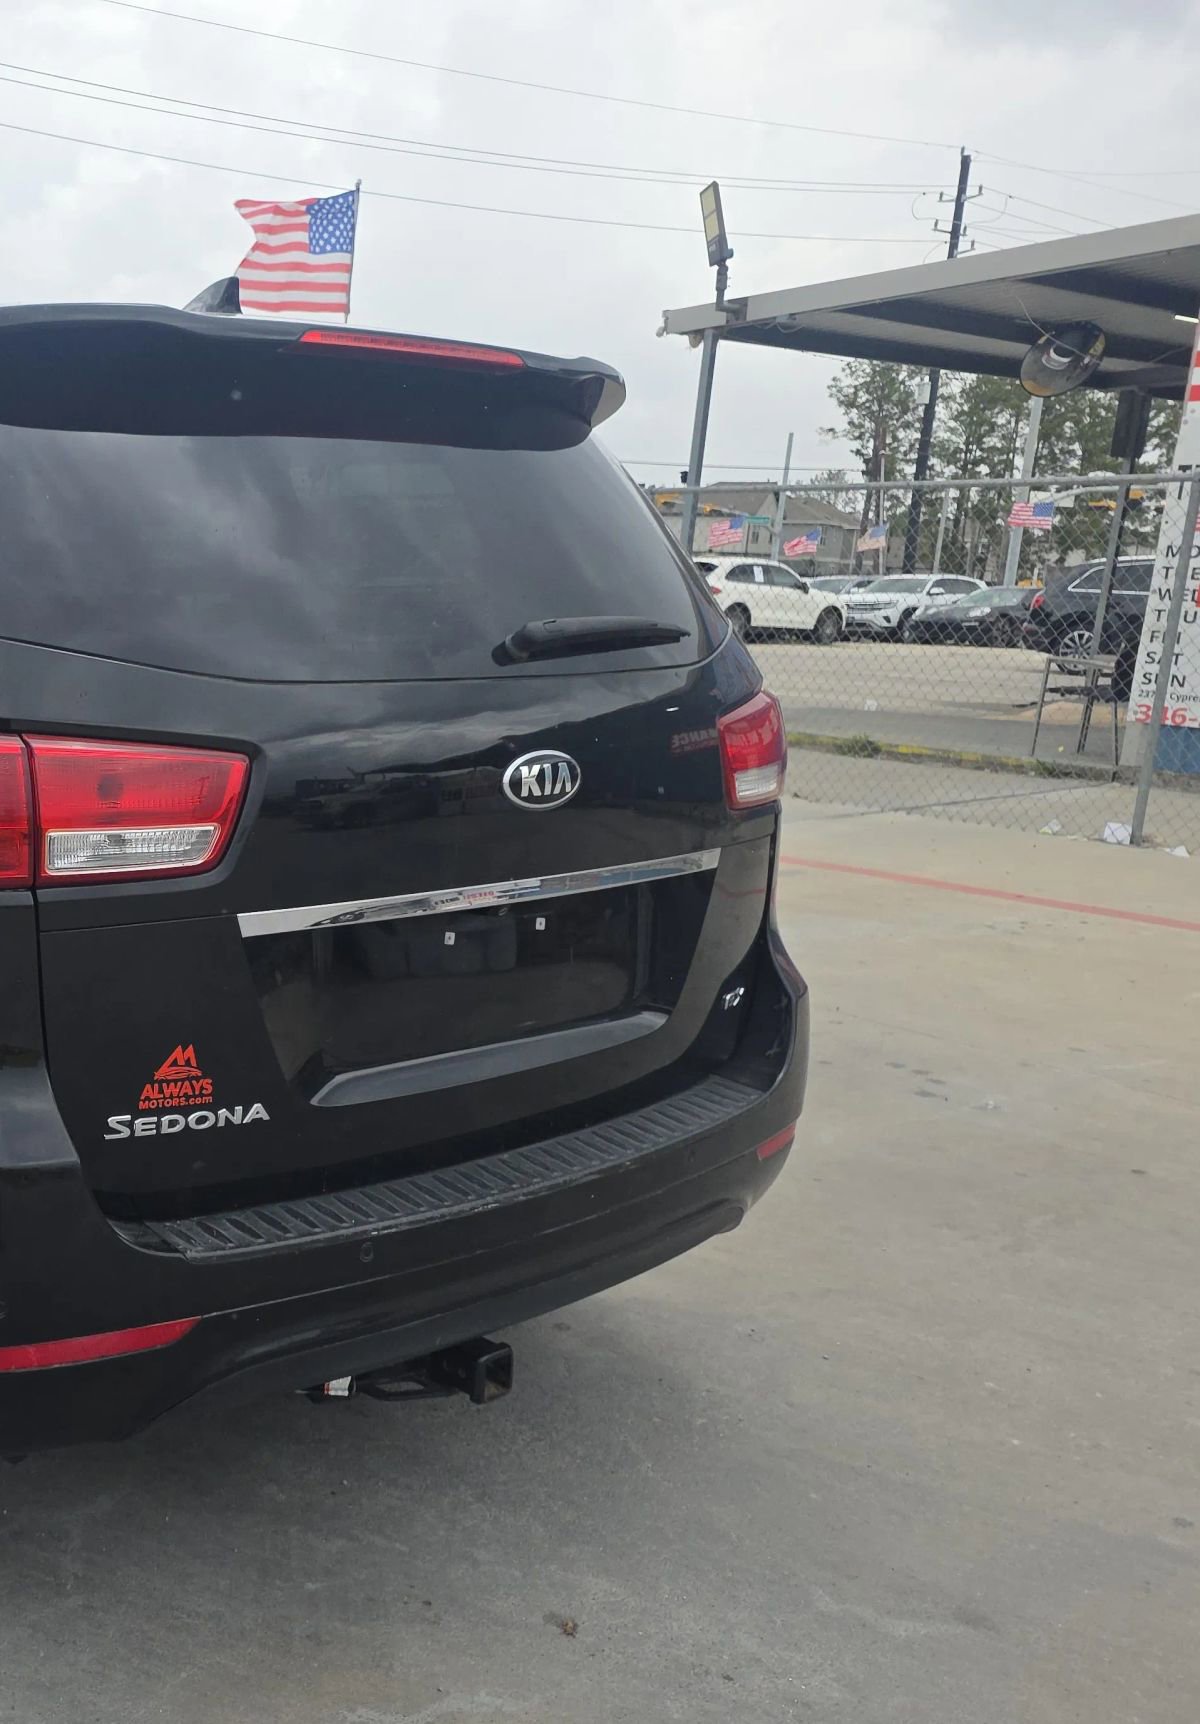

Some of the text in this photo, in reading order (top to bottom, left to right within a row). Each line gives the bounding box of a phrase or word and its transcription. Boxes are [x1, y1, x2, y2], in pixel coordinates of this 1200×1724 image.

[1162, 566, 1200, 580] TE
[1154, 609, 1197, 623] TU
[1150, 630, 1181, 644] FI
[1145, 651, 1183, 665] ST
[1141, 672, 1185, 687] SN
[1170, 692, 1200, 703] Cypre
[519, 762, 572, 797] KIA
[140, 1078, 213, 1100] ALWAYS
[138, 1096, 213, 1110] MOTORS.com
[103, 1102, 271, 1140] SEDONA
